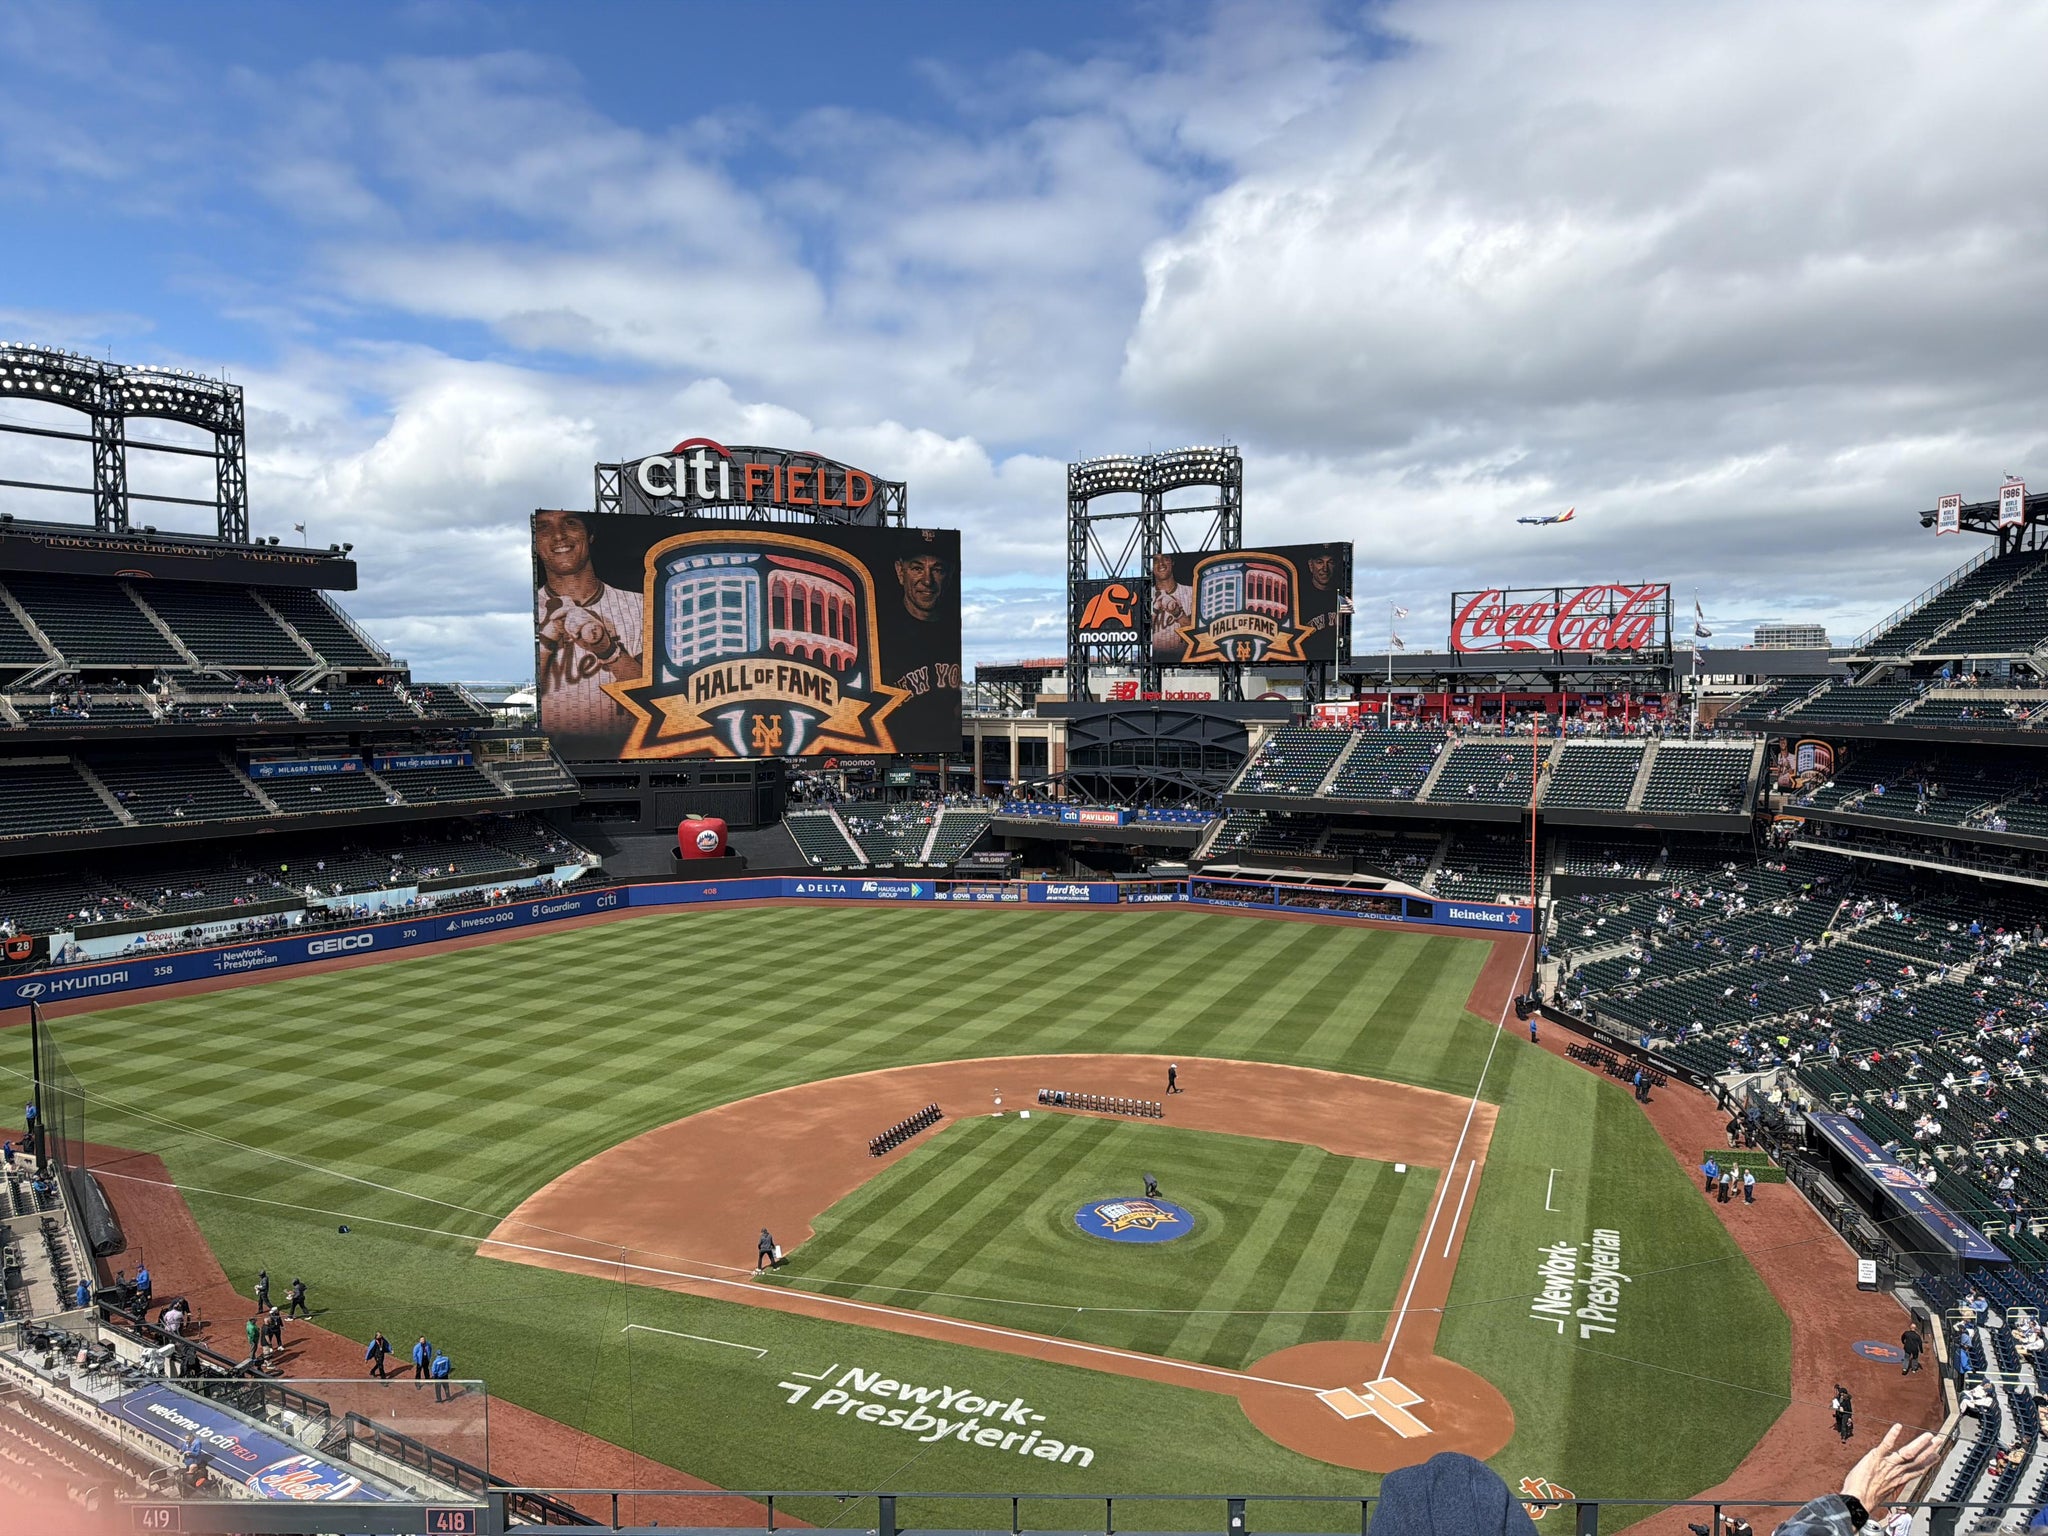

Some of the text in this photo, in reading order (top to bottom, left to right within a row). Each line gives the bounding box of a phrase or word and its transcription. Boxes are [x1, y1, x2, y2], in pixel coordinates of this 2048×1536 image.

[638, 447, 874, 507] citi FIELD
[2003, 488, 2021, 499] 1986
[1942, 498, 1957, 509] 1969
[1451, 582, 1671, 652] Coca-Cola
[1212, 617, 1276, 637] HALL OF FAME
[1079, 631, 1138, 643] moomoo
[696, 665, 833, 707] HALL OF FAME
[1165, 690, 1212, 700] balance
[840, 759, 875, 767] moomoo
[1081, 814, 1116, 822] PAVILION
[703, 887, 717, 895] 408
[808, 884, 846, 893] DELTA
[1047, 885, 1090, 896] Hard Rock
[597, 894, 617, 907] citi
[1209, 900, 1249, 908] CADILLAC
[541, 901, 580, 914] Guardian
[461, 912, 514, 928] Invesco QQQ
[1358, 912, 1403, 921] CADILLAC
[1449, 908, 1504, 923] Heineken
[146, 931, 173, 943] Coors
[203, 926, 229, 936] FIESTA
[402, 929, 417, 939] 370
[16, 941, 29, 952] 28
[307, 933, 374, 955] GEICO
[223, 948, 266, 961] NewYork-
[223, 954, 278, 970] Presbyterian
[153, 966, 173, 976] 358
[51, 971, 128, 993] HYUNDAI
[1576, 1228, 1632, 1323] Presbyterian
[835, 1367, 1046, 1425] NewYork-
[147, 1403, 258, 1462] welcome to citi FIELD
[811, 1389, 1094, 1468] Presbyterian
[143, 1509, 170, 1528] 419
[436, 1512, 465, 1531] 418
